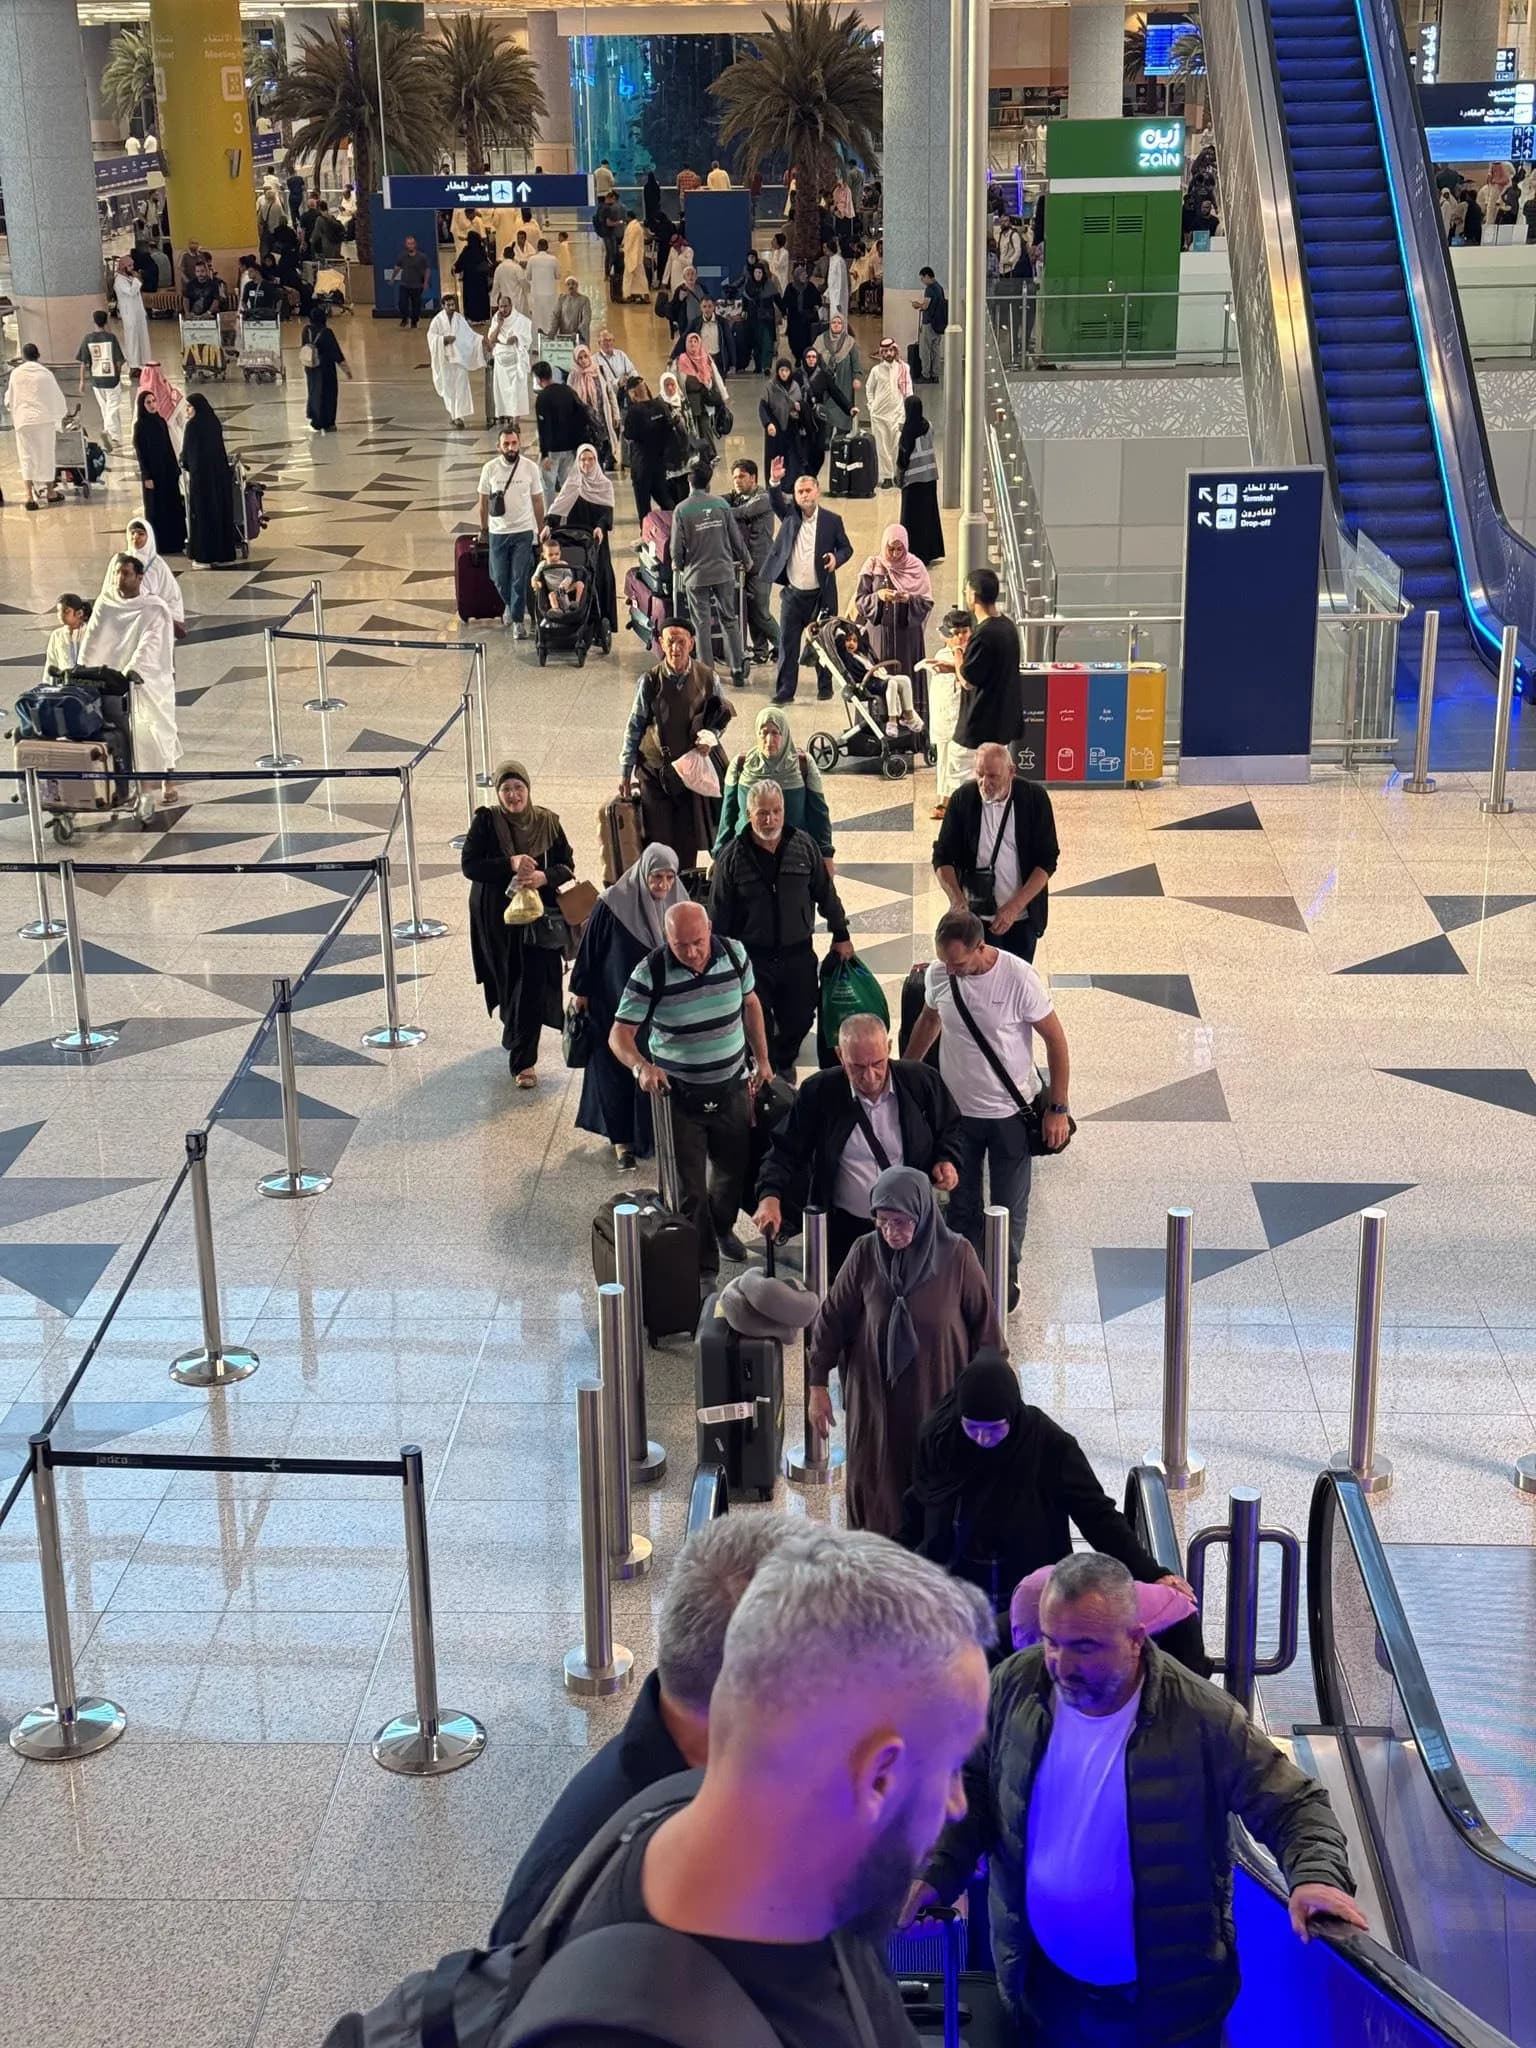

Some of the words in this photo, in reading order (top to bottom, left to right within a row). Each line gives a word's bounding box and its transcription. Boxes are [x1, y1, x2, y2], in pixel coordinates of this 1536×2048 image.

[233, 112, 243, 134] 3
[1140, 122, 1180, 150] زين
[445, 181, 468, 191] المطار
[458, 193, 490, 201] Terminal
[1242, 483, 1266, 493] المطار
[1268, 483, 1289, 491] صالة
[1242, 493, 1273, 502] Terminal
[1241, 508, 1276, 518] المغادرون
[1241, 519, 1271, 528] Drop-off
